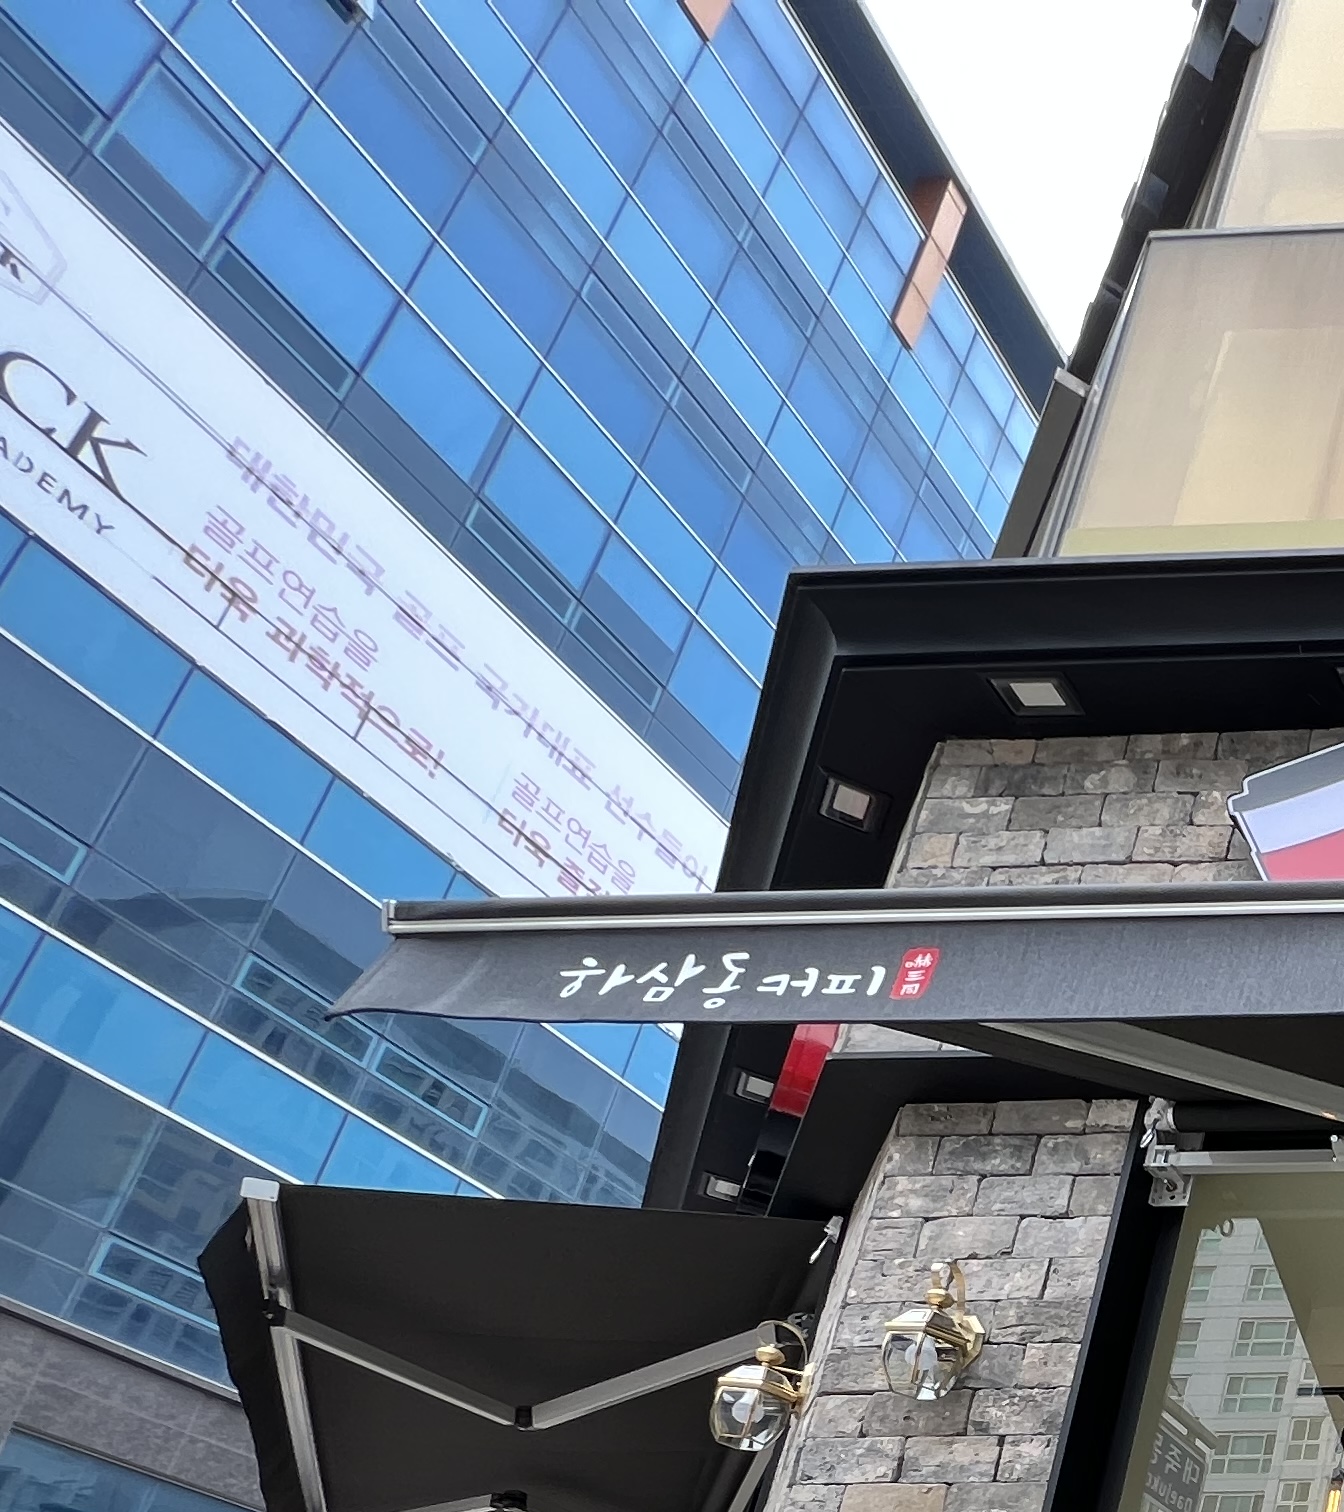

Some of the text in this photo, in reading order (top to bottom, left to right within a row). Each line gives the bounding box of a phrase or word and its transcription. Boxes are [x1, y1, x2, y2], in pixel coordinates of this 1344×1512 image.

[183, 543, 445, 779] 더욱 과학적으로!
[203, 505, 379, 672] 골프연습을
[226, 436, 385, 596] 대한민국
[392, 589, 466, 672] 골프
[475, 663, 597, 791] 국가대표
[498, 808, 551, 868] 더욱
[511, 772, 637, 895] 골프연습을
[560, 952, 886, 1009] 하삼동 커피
